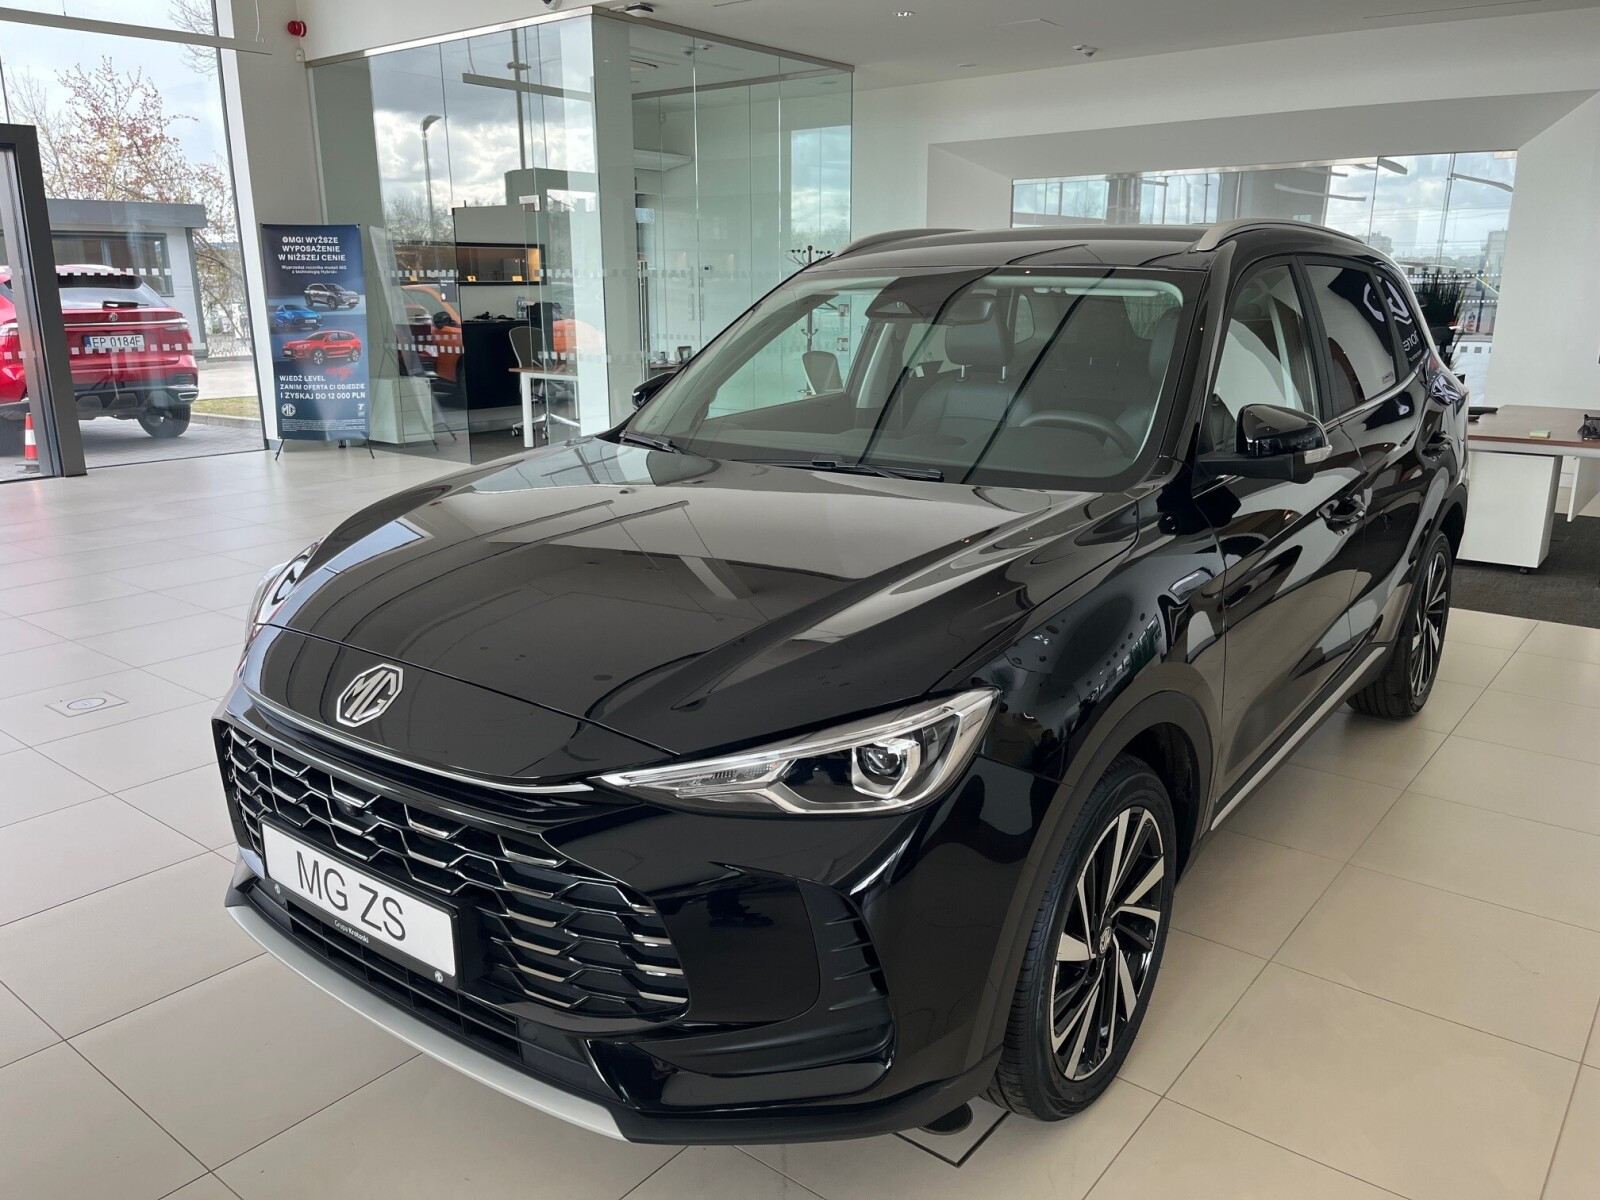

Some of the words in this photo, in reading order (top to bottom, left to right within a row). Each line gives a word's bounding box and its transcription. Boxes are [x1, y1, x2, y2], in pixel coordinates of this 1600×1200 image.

[306, 235, 338, 243] WYŻSZE
[282, 244, 340, 252] WYPOSAŻENIE
[92, 338, 106, 347] EP
[341, 667, 399, 723] MG
[296, 850, 348, 911] MG
[359, 883, 406, 941] ZS
